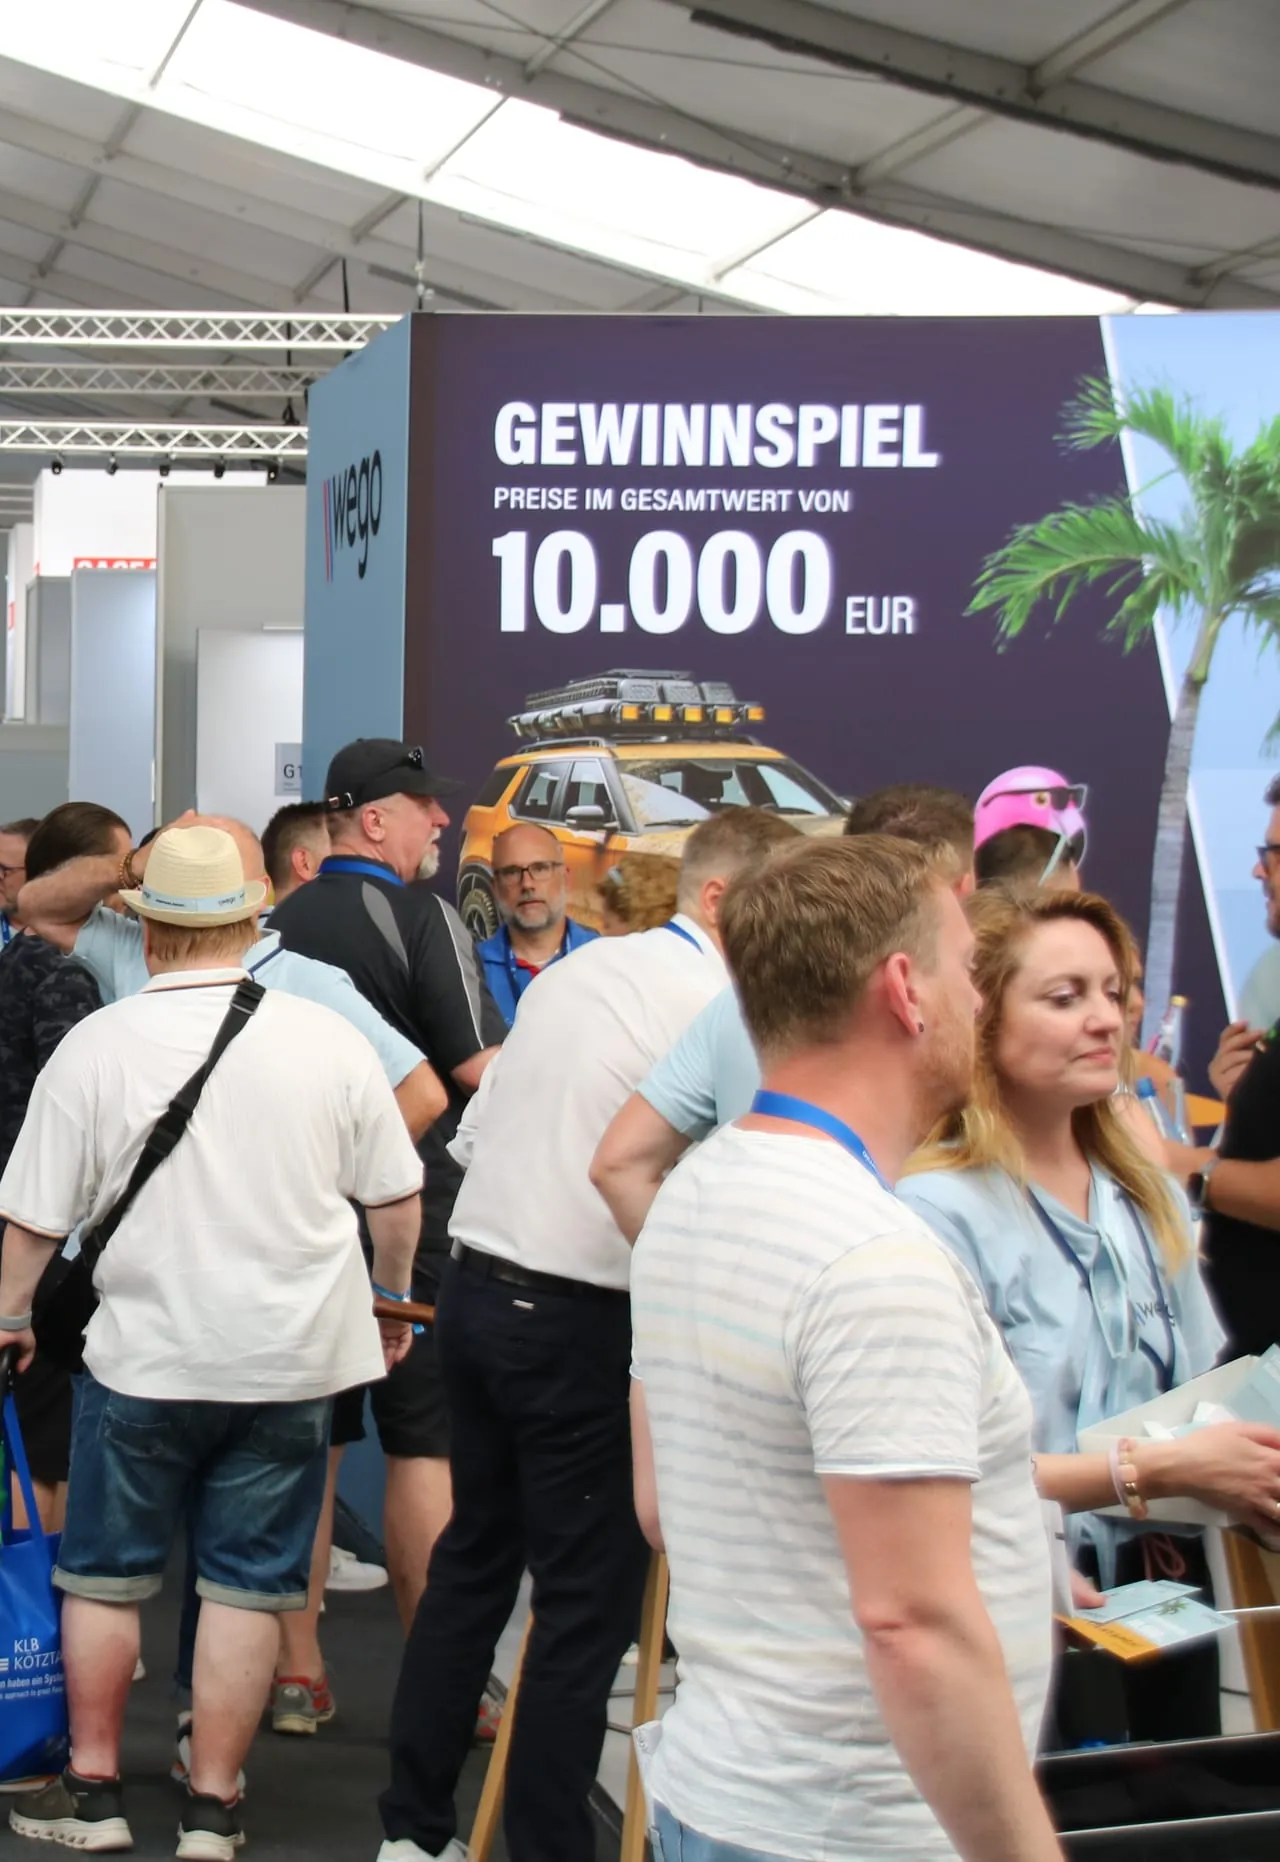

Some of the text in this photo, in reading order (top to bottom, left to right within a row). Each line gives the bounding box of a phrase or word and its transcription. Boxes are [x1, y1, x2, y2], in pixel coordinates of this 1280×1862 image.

[493, 401, 940, 468] GEWINNSPIEL
[332, 449, 383, 580] wego
[493, 486, 851, 513] PREISE IM GESAMTWERT VON
[491, 529, 916, 636] 10.000 EUR
[14, 1637, 40, 1654] KLB
[14, 1650, 64, 1671] KÖTZTA
